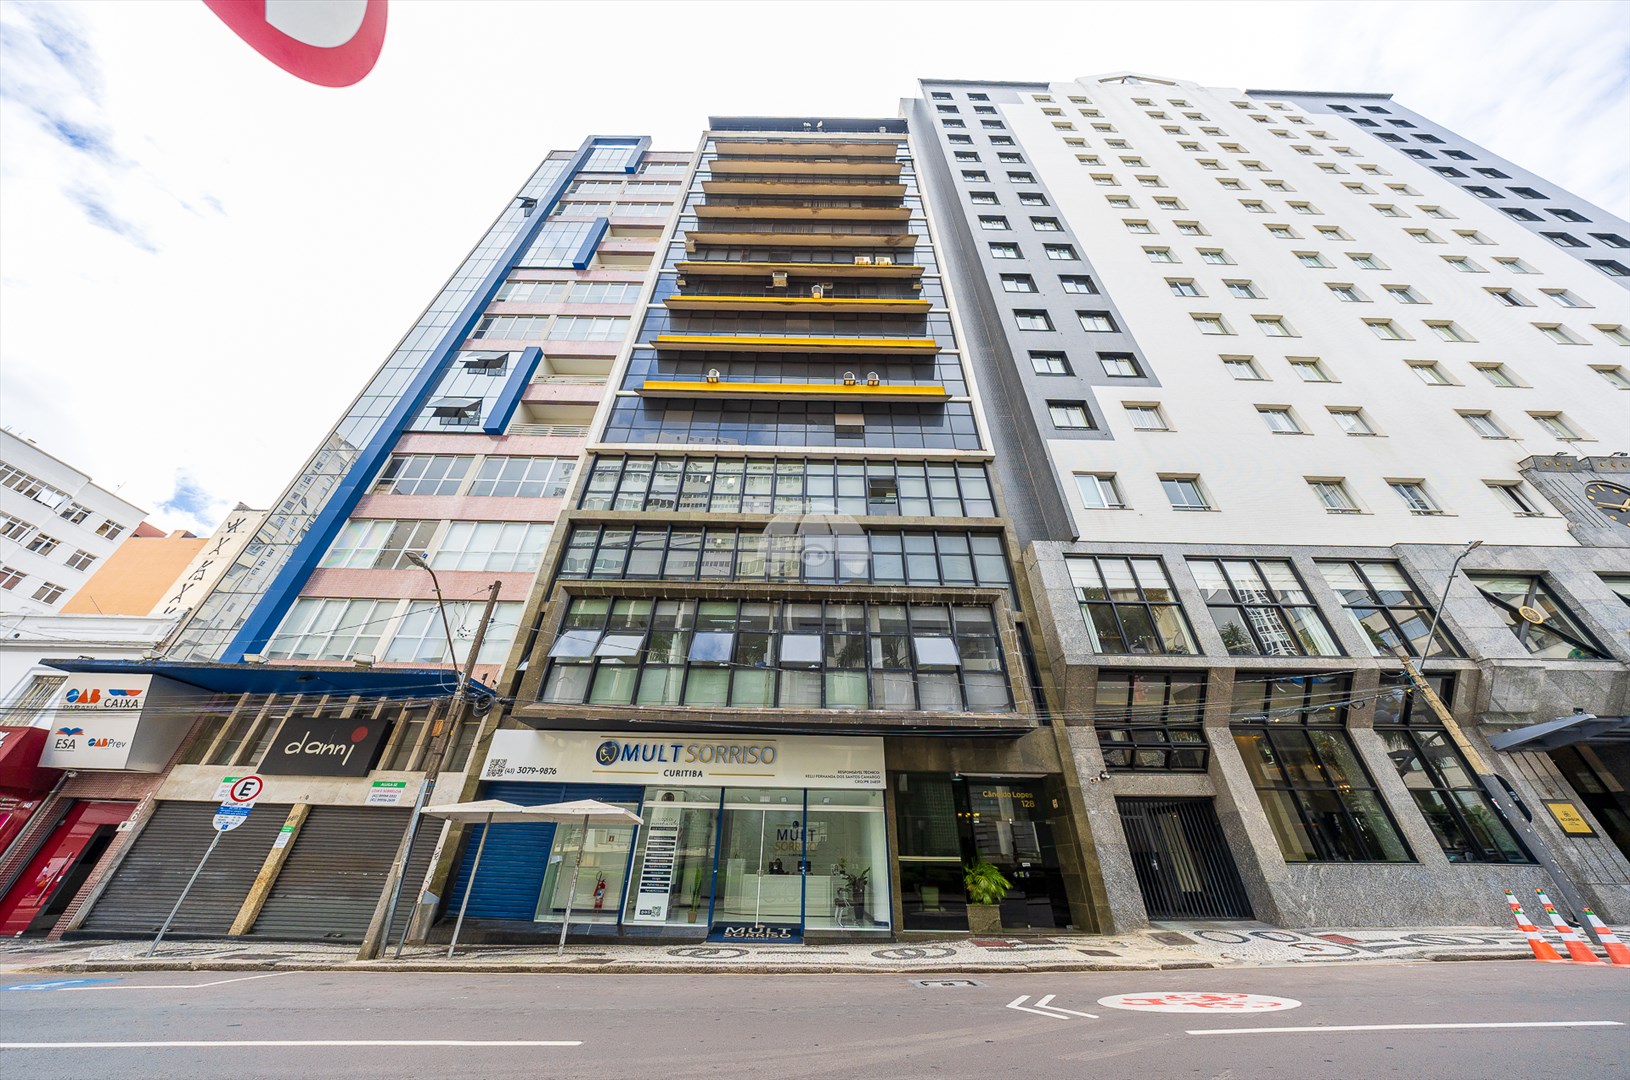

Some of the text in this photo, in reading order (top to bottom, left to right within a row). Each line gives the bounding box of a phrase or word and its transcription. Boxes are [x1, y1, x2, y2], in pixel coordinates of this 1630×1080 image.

[104, 698, 138, 708] CAIXA
[55, 738, 76, 749] ESA
[620, 743, 777, 765] MULT SORRISO
[516, 766, 557, 775] 3079-9876
[663, 769, 703, 778] CURITIBA
[238, 781, 255, 796] E
[1012, 791, 1033, 799] Lopes
[1021, 800, 1035, 808] 128
[774, 841, 817, 852] SORRO
